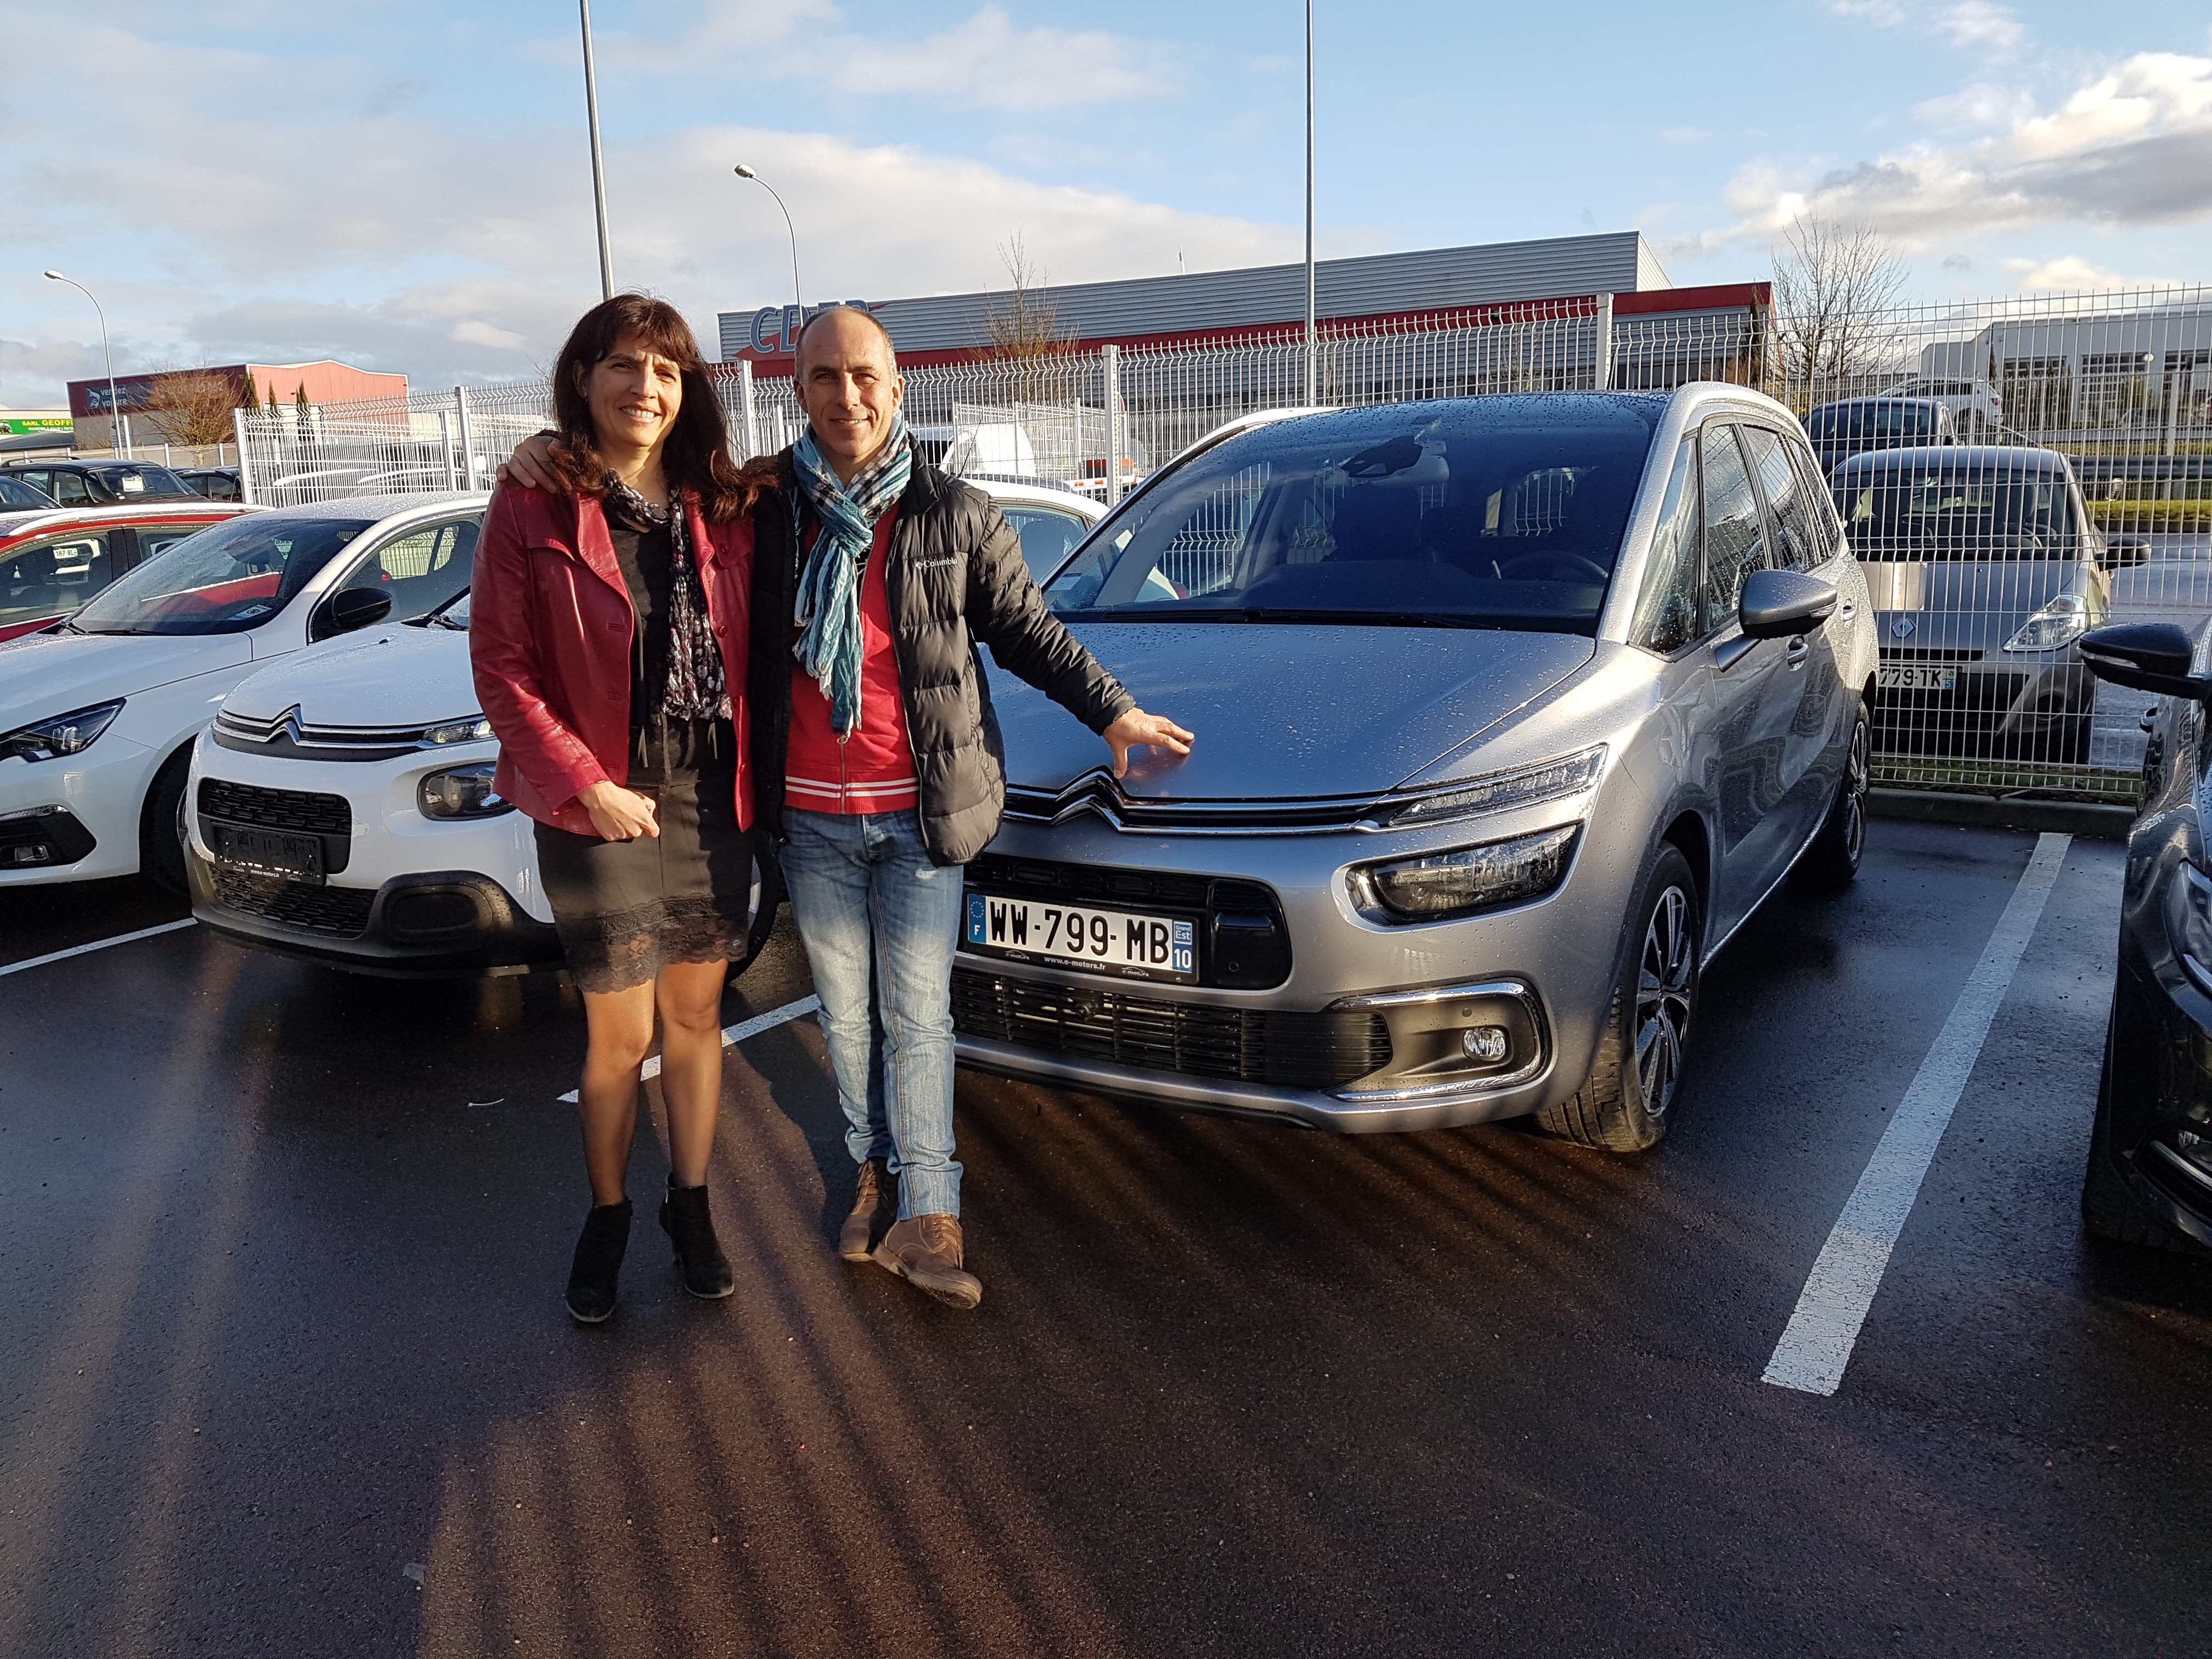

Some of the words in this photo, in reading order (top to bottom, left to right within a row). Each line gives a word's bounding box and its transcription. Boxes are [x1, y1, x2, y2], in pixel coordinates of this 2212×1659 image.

[749, 300, 870, 354] CD
[101, 397, 128, 408] voiure
[923, 557, 958, 568] Columbia
[974, 924, 980, 935] F
[990, 901, 1169, 964] WW-799-MB
[1175, 930, 1190, 940] Est
[1044, 956, 1106, 970] www.e-motors.fr
[1174, 948, 1192, 969] 10
